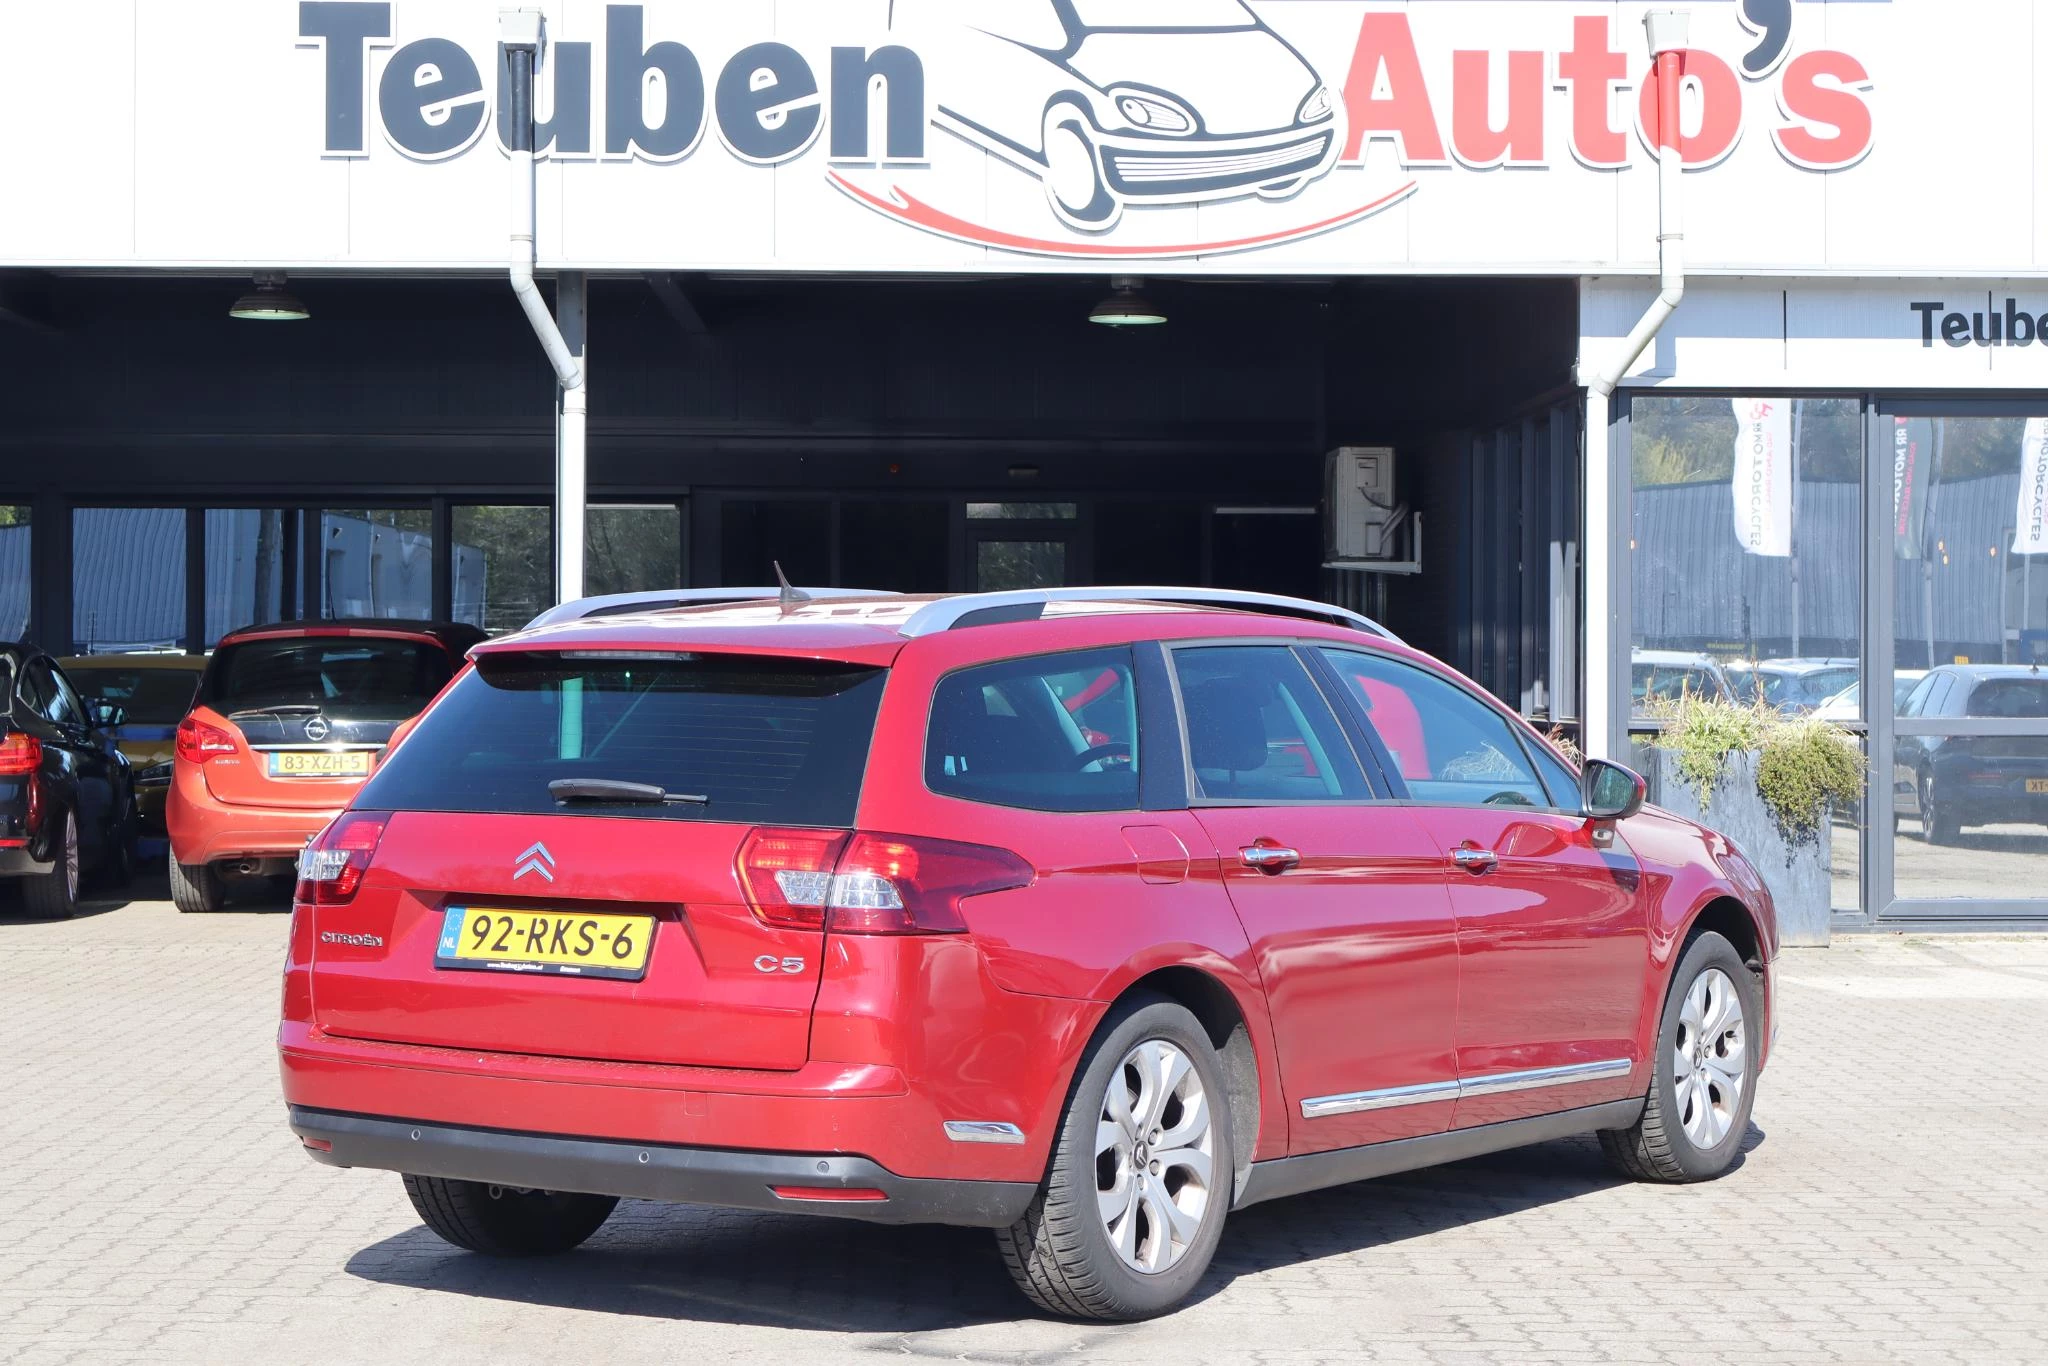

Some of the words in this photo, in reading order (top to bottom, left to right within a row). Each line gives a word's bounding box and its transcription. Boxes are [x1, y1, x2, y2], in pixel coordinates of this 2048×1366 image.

[298, 1, 925, 159] Teuben
[1338, 0, 1872, 163] Auto's
[284, 755, 361, 770] 83-XZH-5
[321, 931, 383, 947] CITROËN
[442, 937, 456, 949] NL
[471, 915, 633, 959] 92-RKS-6
[754, 955, 805, 974] C5
